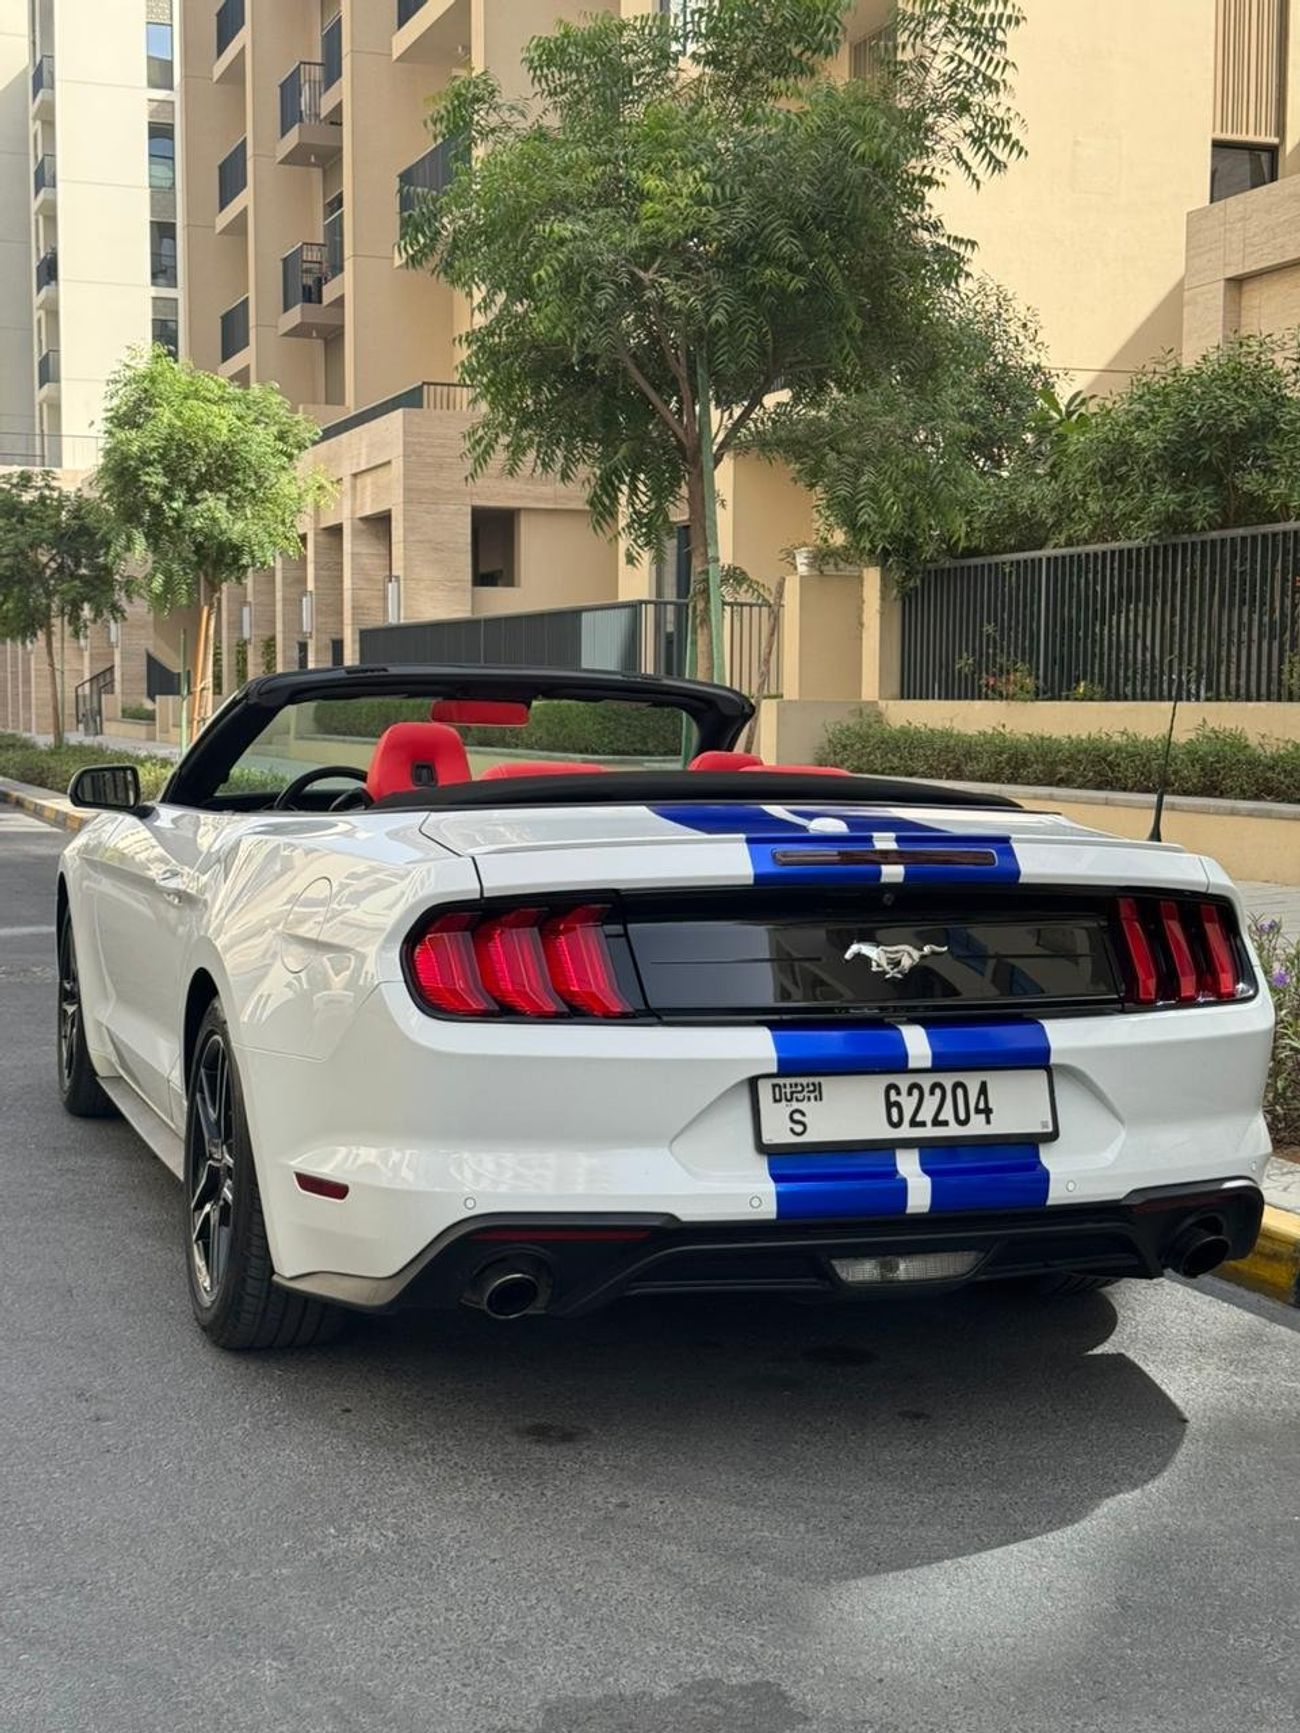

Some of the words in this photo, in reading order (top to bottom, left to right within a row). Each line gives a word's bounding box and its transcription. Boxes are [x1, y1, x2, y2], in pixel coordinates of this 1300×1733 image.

[771, 1081, 823, 1104] DUBAI
[884, 1080, 994, 1129] 62204
[789, 1108, 808, 1137] S
